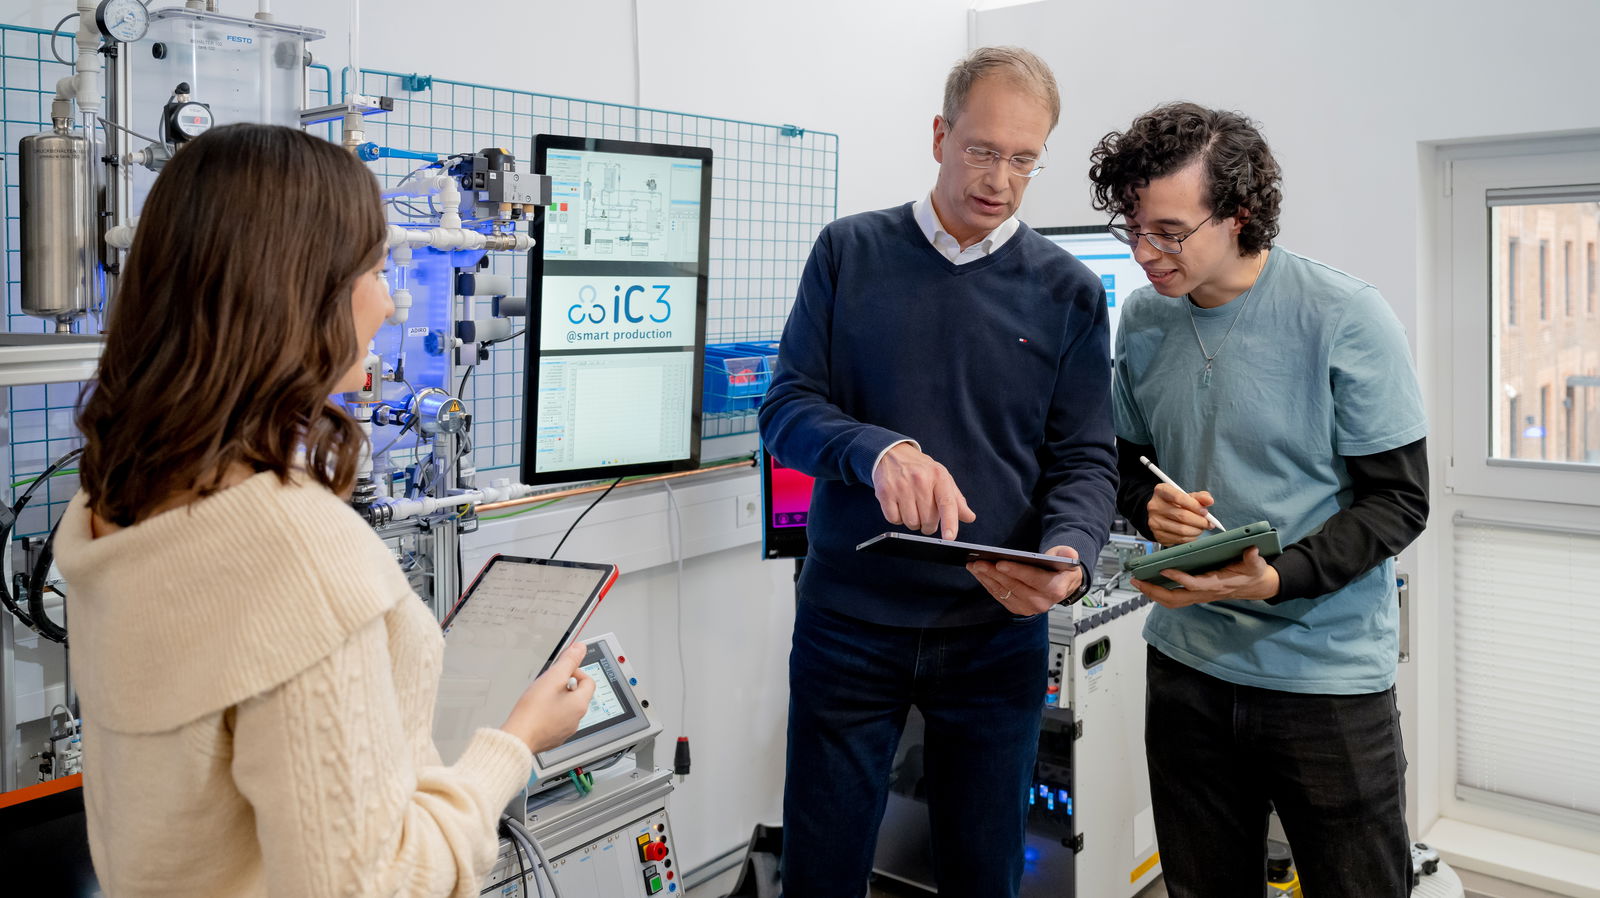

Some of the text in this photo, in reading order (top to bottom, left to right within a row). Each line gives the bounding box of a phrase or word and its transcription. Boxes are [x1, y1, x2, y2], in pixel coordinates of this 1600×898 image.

[226, 35, 253, 44] FESTO
[613, 284, 672, 324] iC3
[566, 329, 672, 343] @smart production
[600, 657, 617, 683] TOUCH
